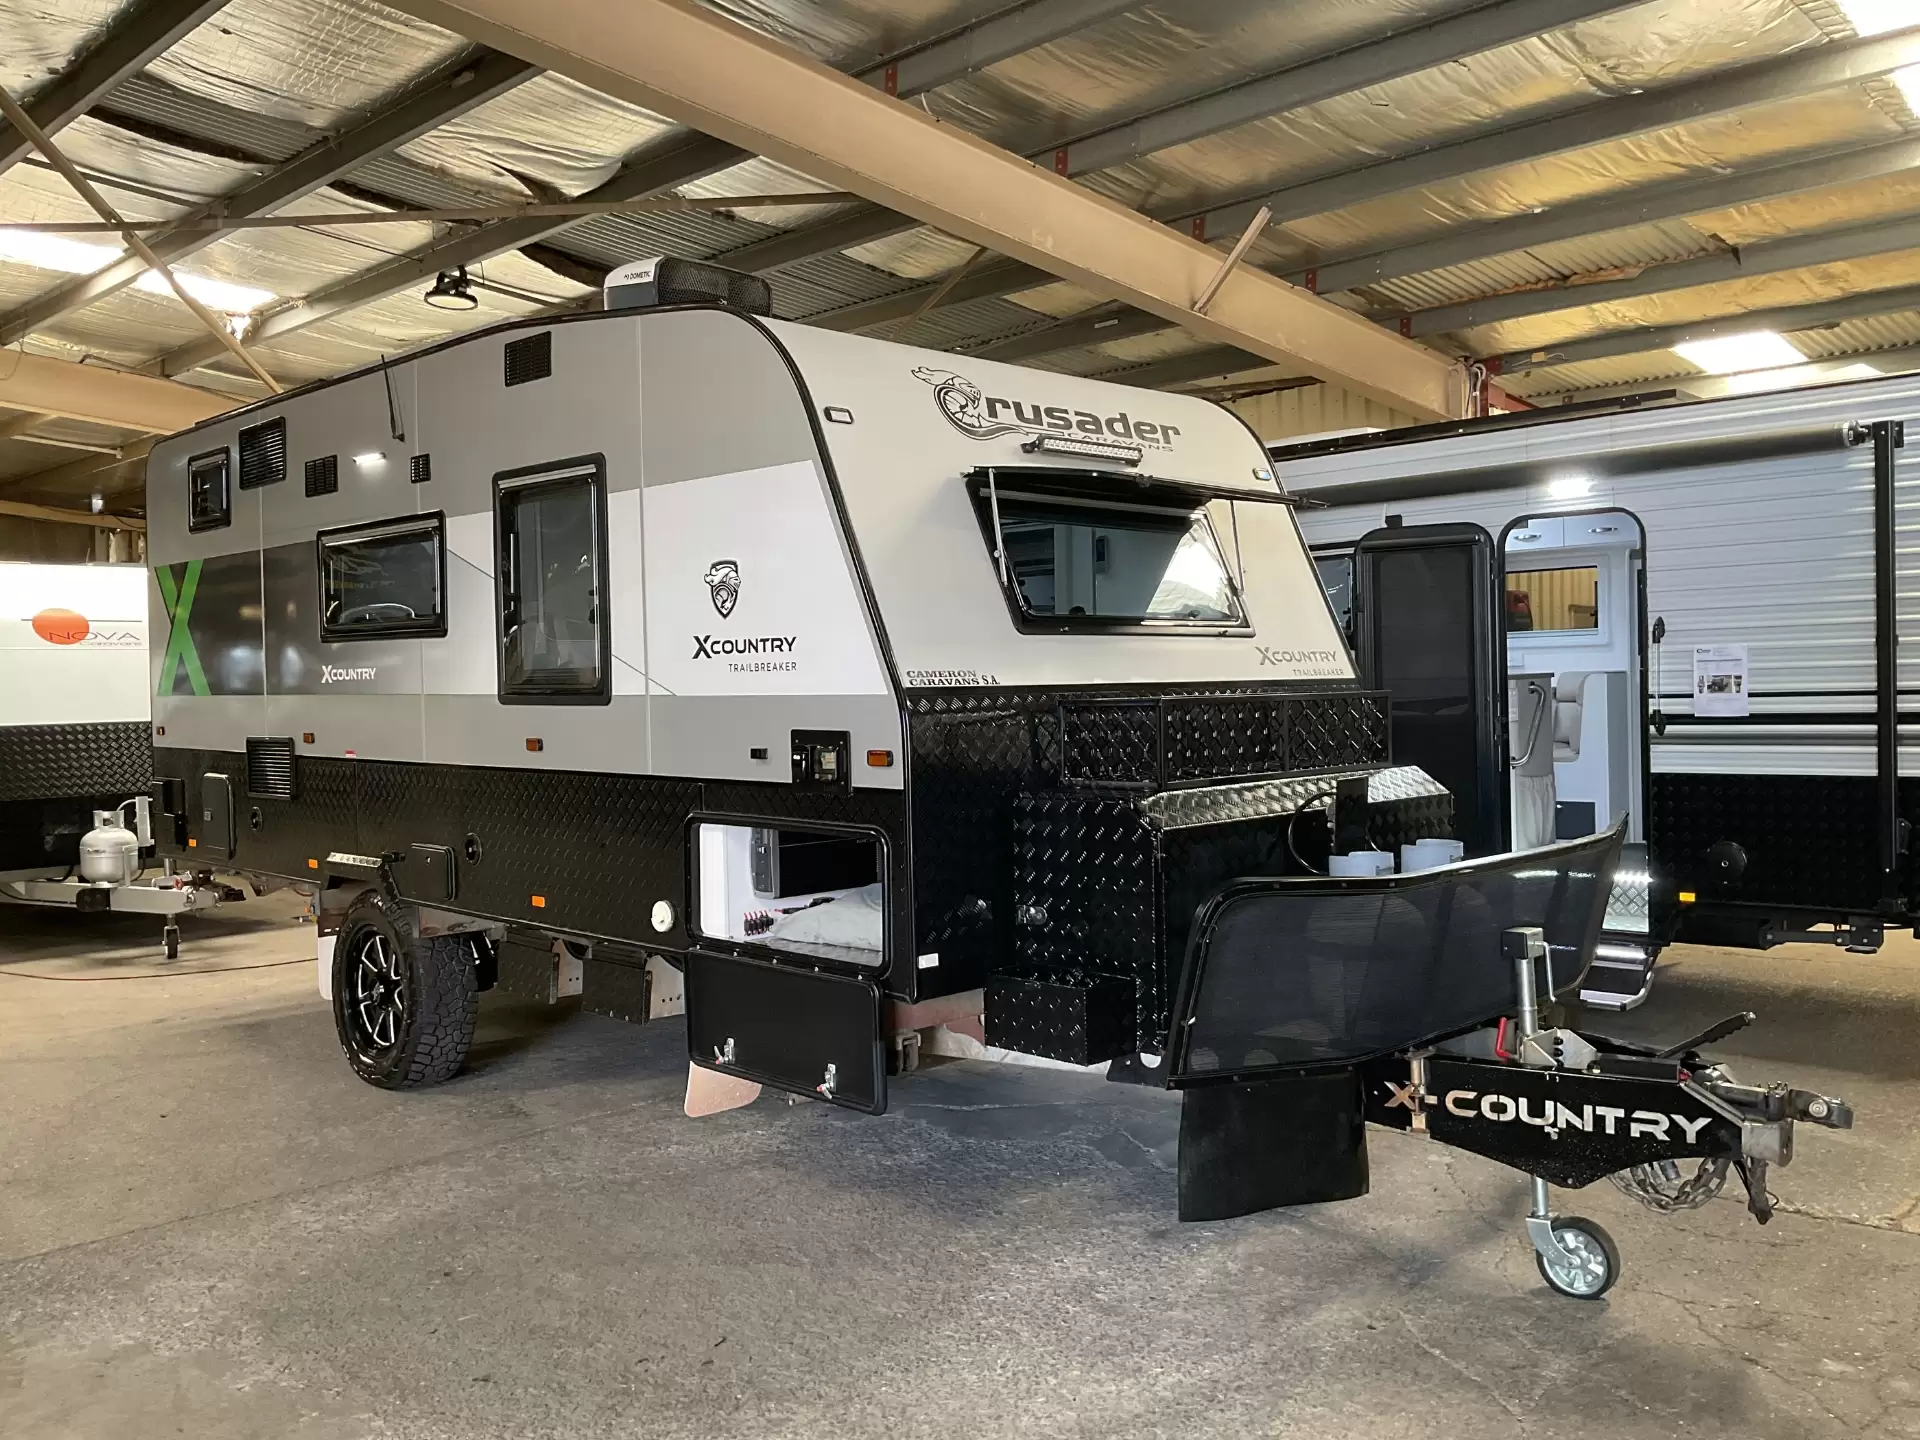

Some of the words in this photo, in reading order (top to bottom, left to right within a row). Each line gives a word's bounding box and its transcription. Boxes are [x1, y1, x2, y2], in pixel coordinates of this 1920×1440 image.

[630, 270, 651, 279] DOMETIC
[49, 632, 140, 641] NOVA
[692, 635, 797, 659] XCOUNTRY
[1255, 646, 1336, 665] XCOUNTRY
[728, 662, 797, 672] TRAILBREAKER
[1293, 668, 1345, 676] TRAILBREAKER
[321, 665, 377, 684] XCOUNTRY
[906, 670, 977, 678] CAMERON
[909, 678, 980, 686] CARAVANS
[981, 675, 1000, 685] S.A.
[1384, 1081, 1713, 1144] X-COUNTRY
